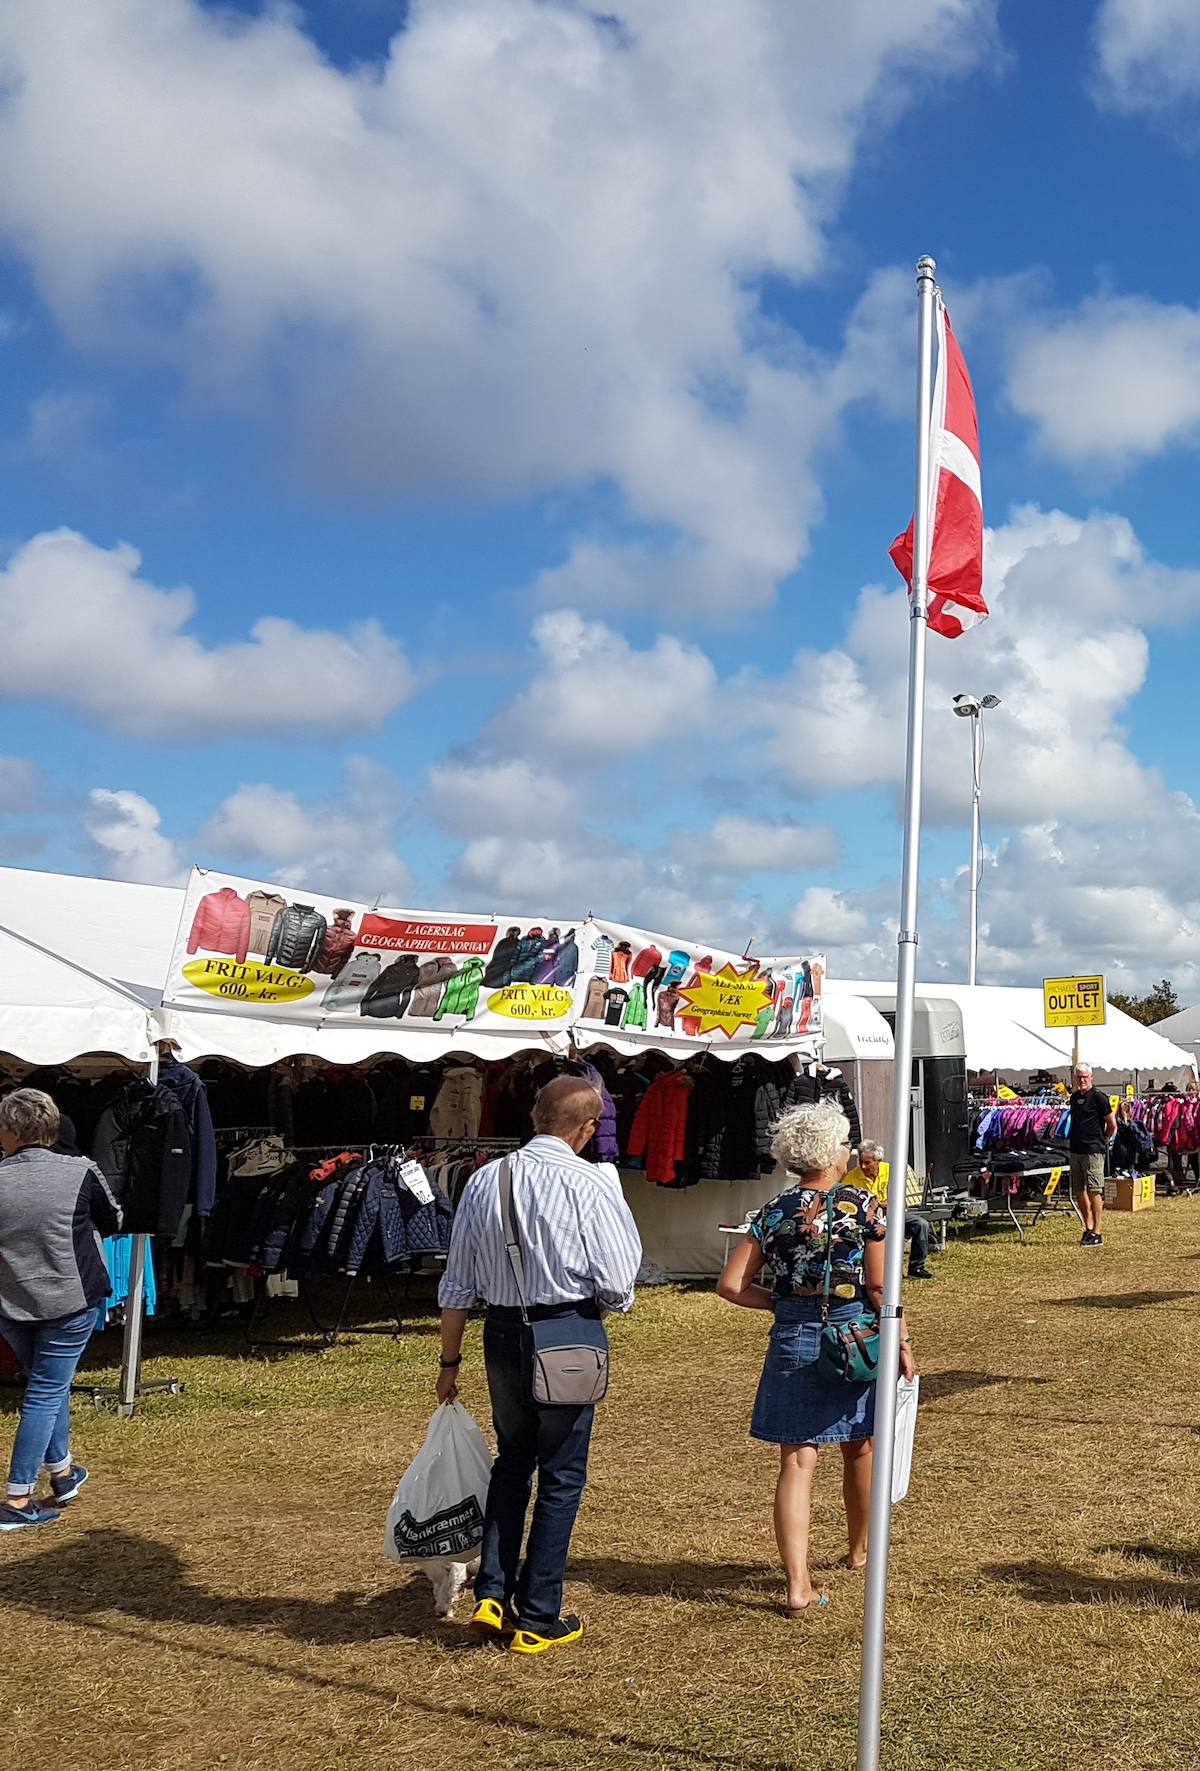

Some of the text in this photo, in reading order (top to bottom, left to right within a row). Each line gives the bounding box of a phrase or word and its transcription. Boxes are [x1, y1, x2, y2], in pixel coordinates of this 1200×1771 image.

[404, 924, 467, 937] LAGERSLAG
[360, 933, 490, 952] GEOGRAPHICAL NORWAY
[203, 959, 307, 989] FRIT VALG!
[1079, 982, 1098, 991] SPORT
[258, 988, 278, 1001] kr.
[500, 988, 569, 1002] FRIT VALG!
[1048, 993, 1099, 1010] OUTLET
[541, 1004, 556, 1016] kr.
[691, 1005, 753, 1019] Geographical Norway
